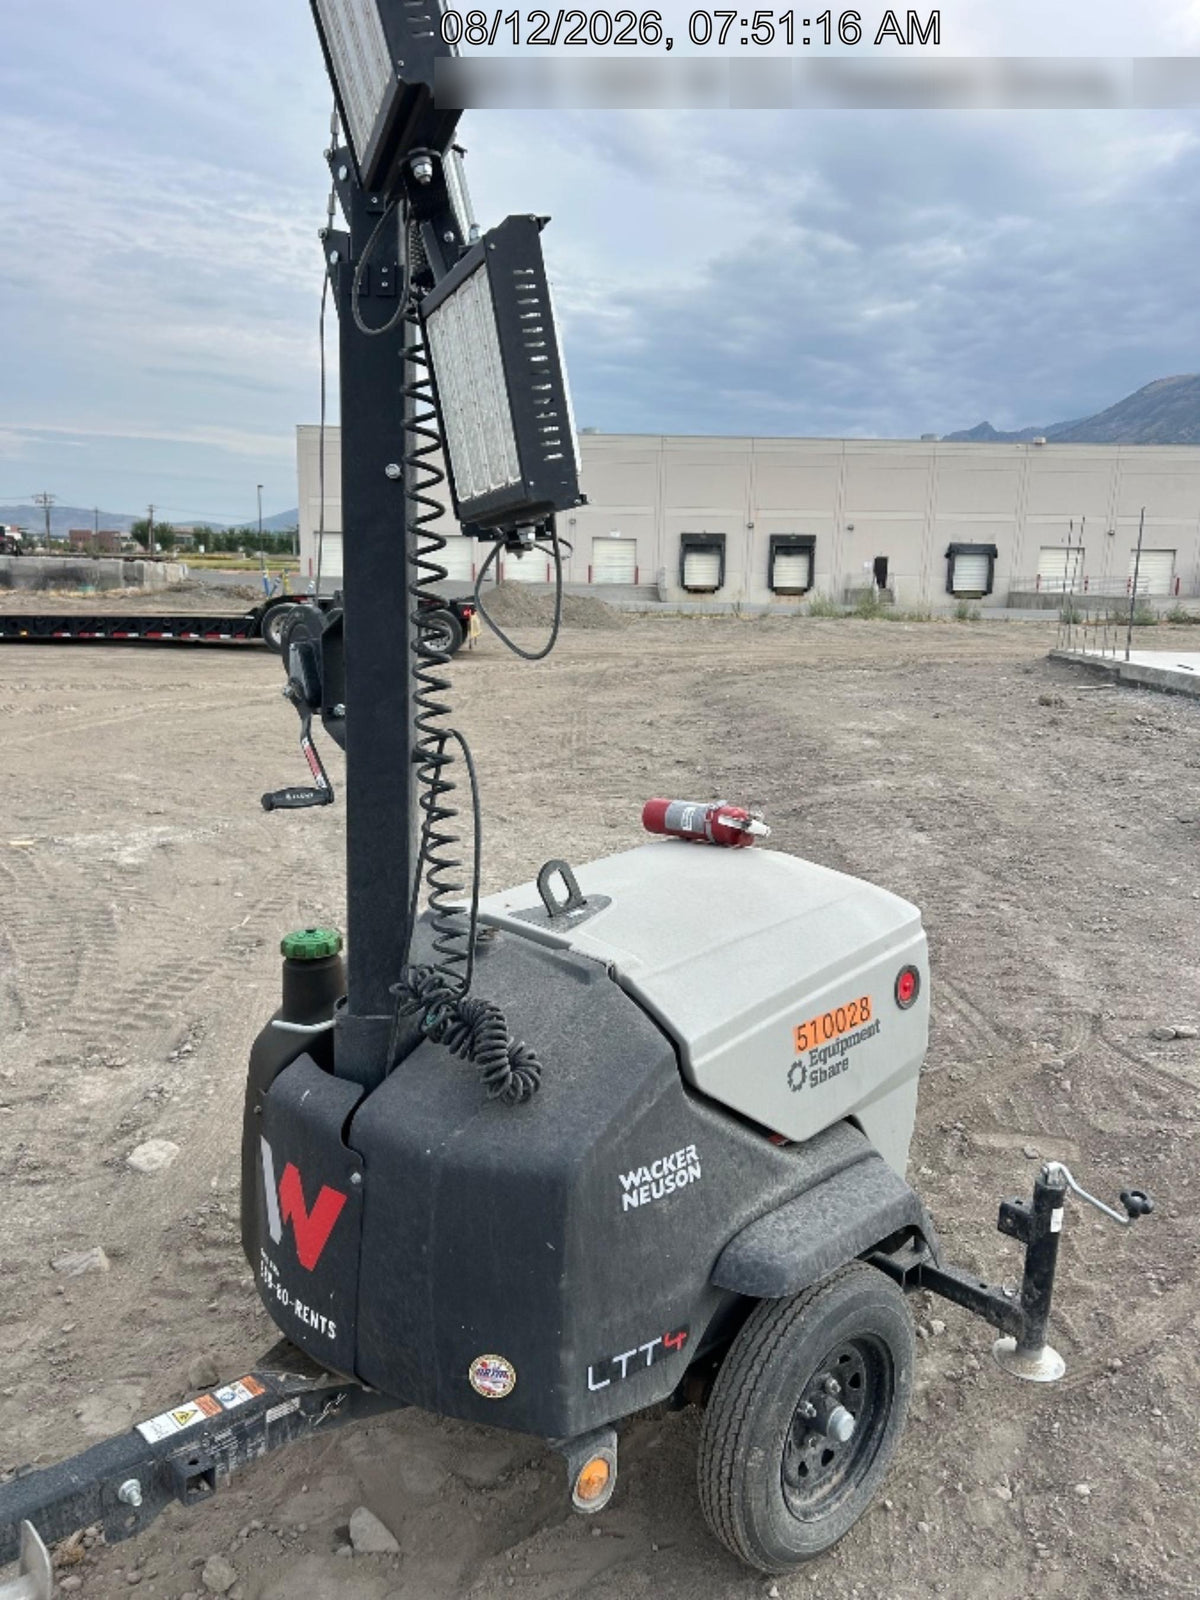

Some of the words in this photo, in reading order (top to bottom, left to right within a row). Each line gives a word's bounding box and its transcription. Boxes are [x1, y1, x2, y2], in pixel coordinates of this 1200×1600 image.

[796, 996, 871, 1052] 510028
[808, 1018, 881, 1068] Equipment
[809, 1057, 849, 1089] Share
[618, 1144, 700, 1191] WACKER
[622, 1161, 702, 1212] NEUSON
[587, 1331, 687, 1391] LTT4
